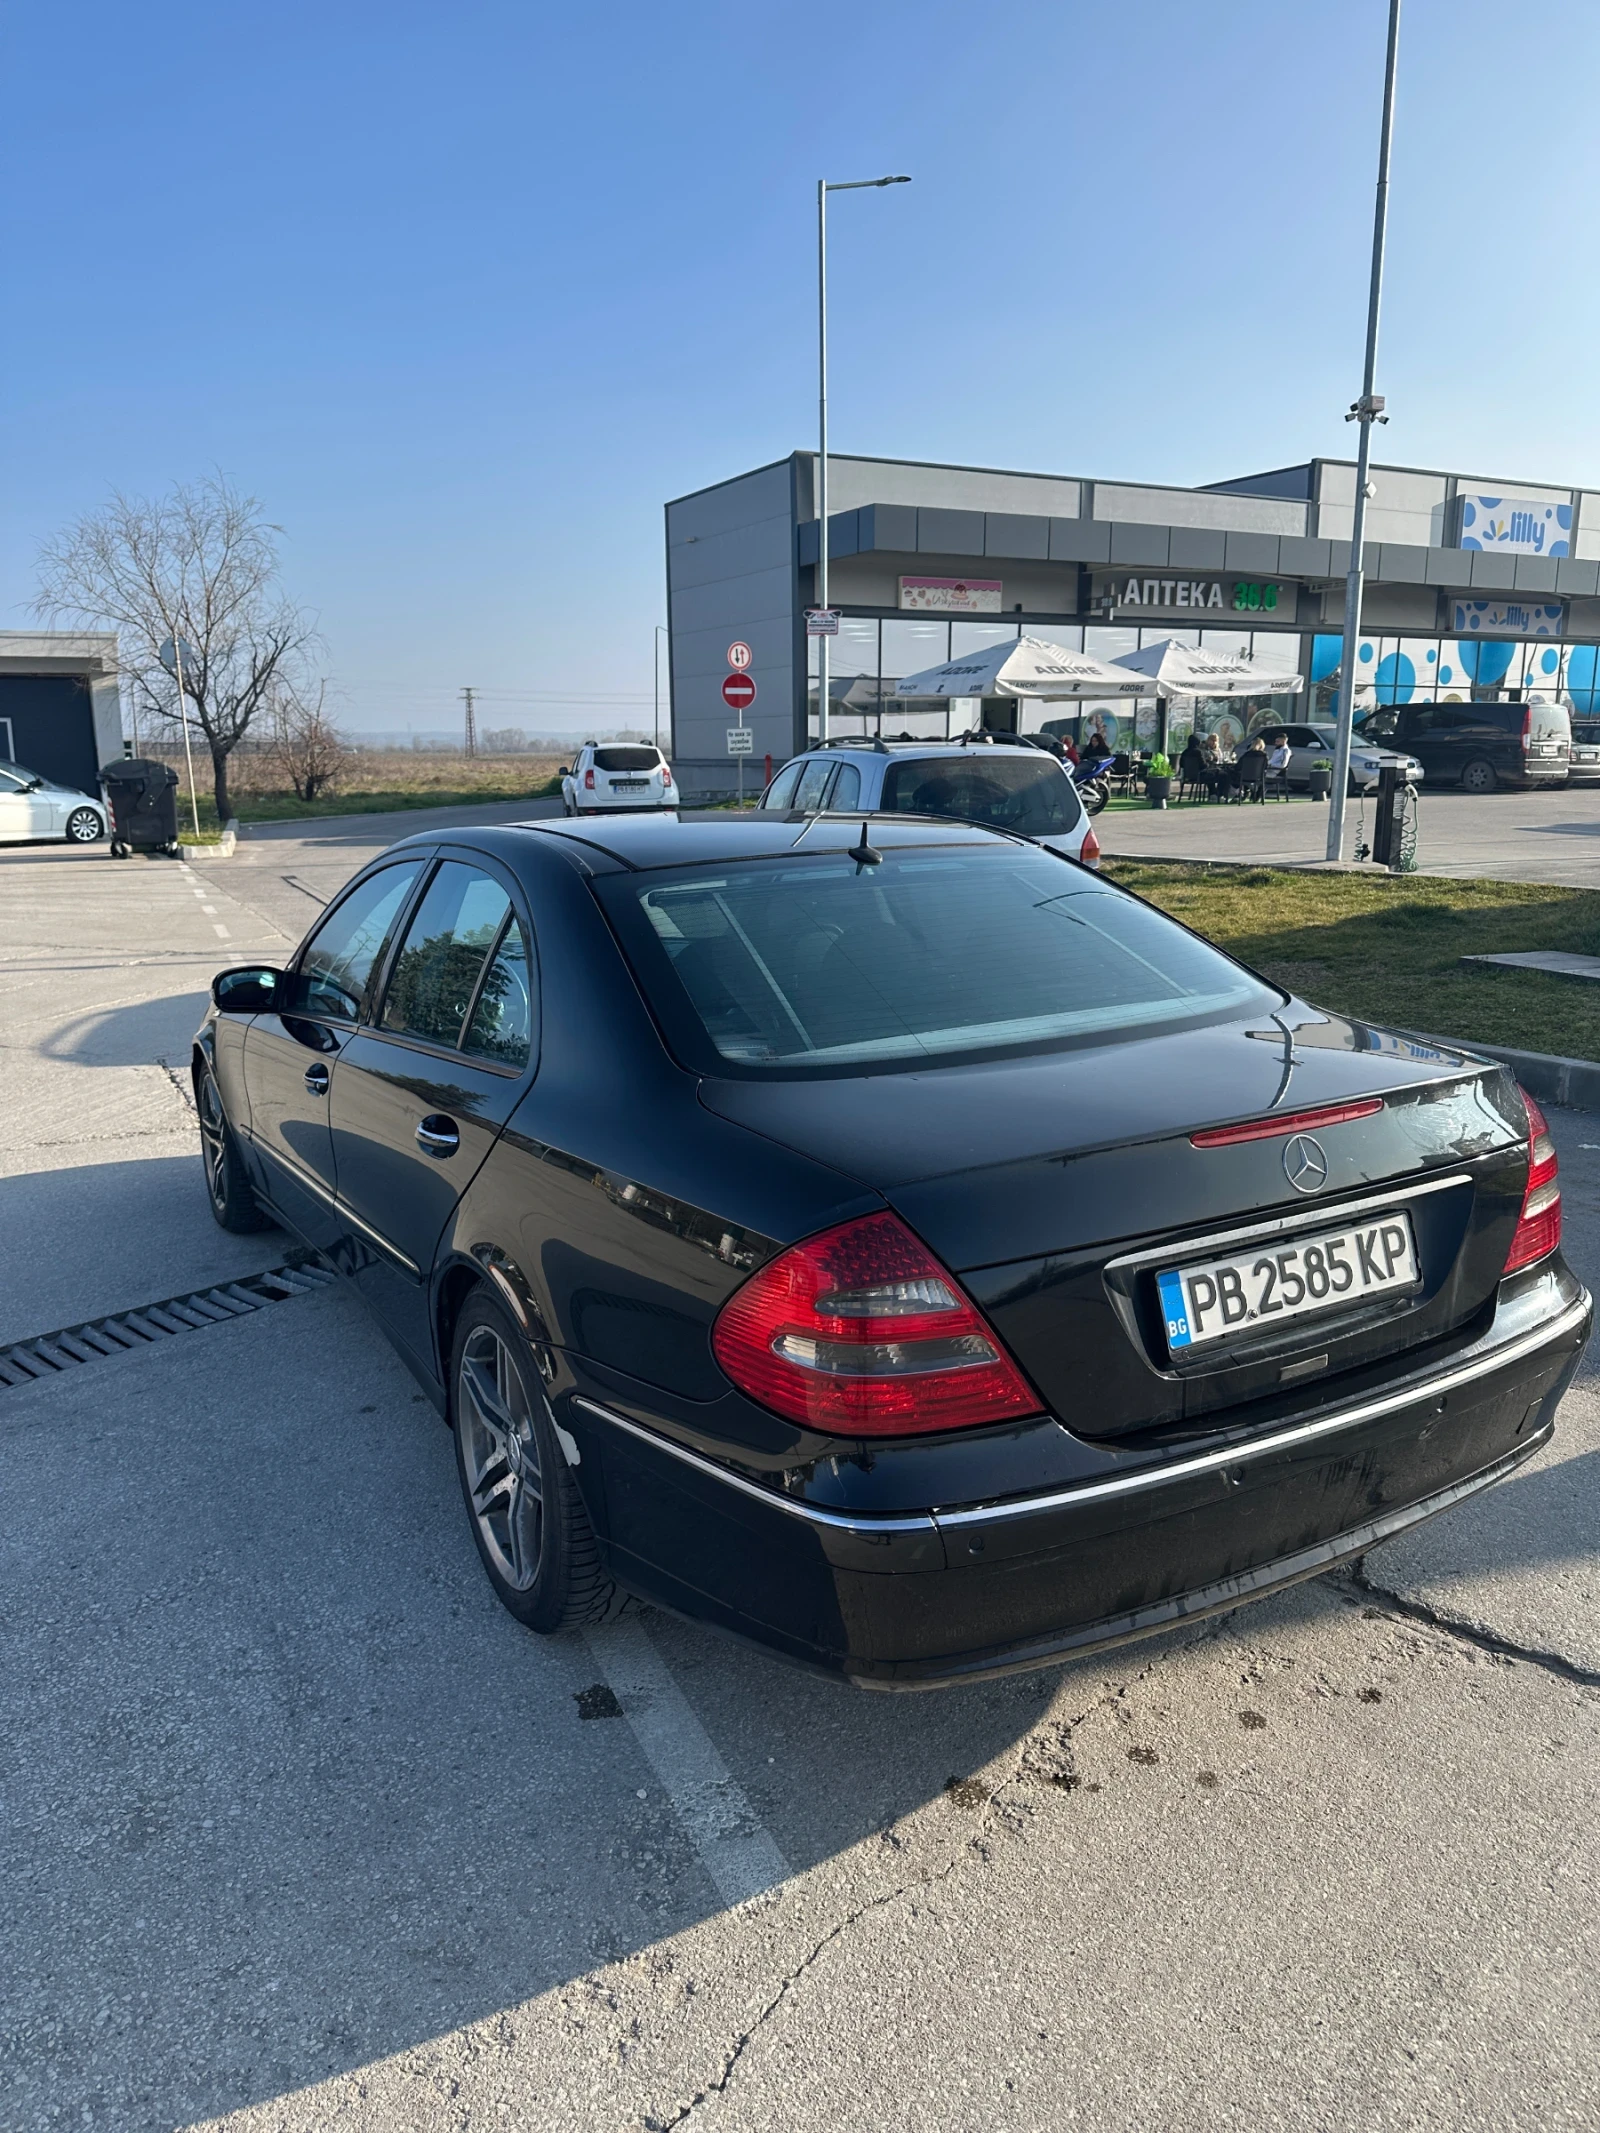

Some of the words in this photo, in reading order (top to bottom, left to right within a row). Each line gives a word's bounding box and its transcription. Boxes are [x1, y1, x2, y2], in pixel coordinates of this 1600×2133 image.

[1509, 511, 1545, 553] lilly
[1123, 578, 1223, 608] АПТЕКА
[1506, 605, 1530, 632] lilly
[1034, 665, 1103, 675] ADORE
[1187, 666, 1251, 674] ADORE
[1119, 684, 1145, 692] ADORE
[1253, 1238, 1353, 1315] 2585
[1355, 1224, 1406, 1285] KP
[1168, 1320, 1188, 1337] BG
